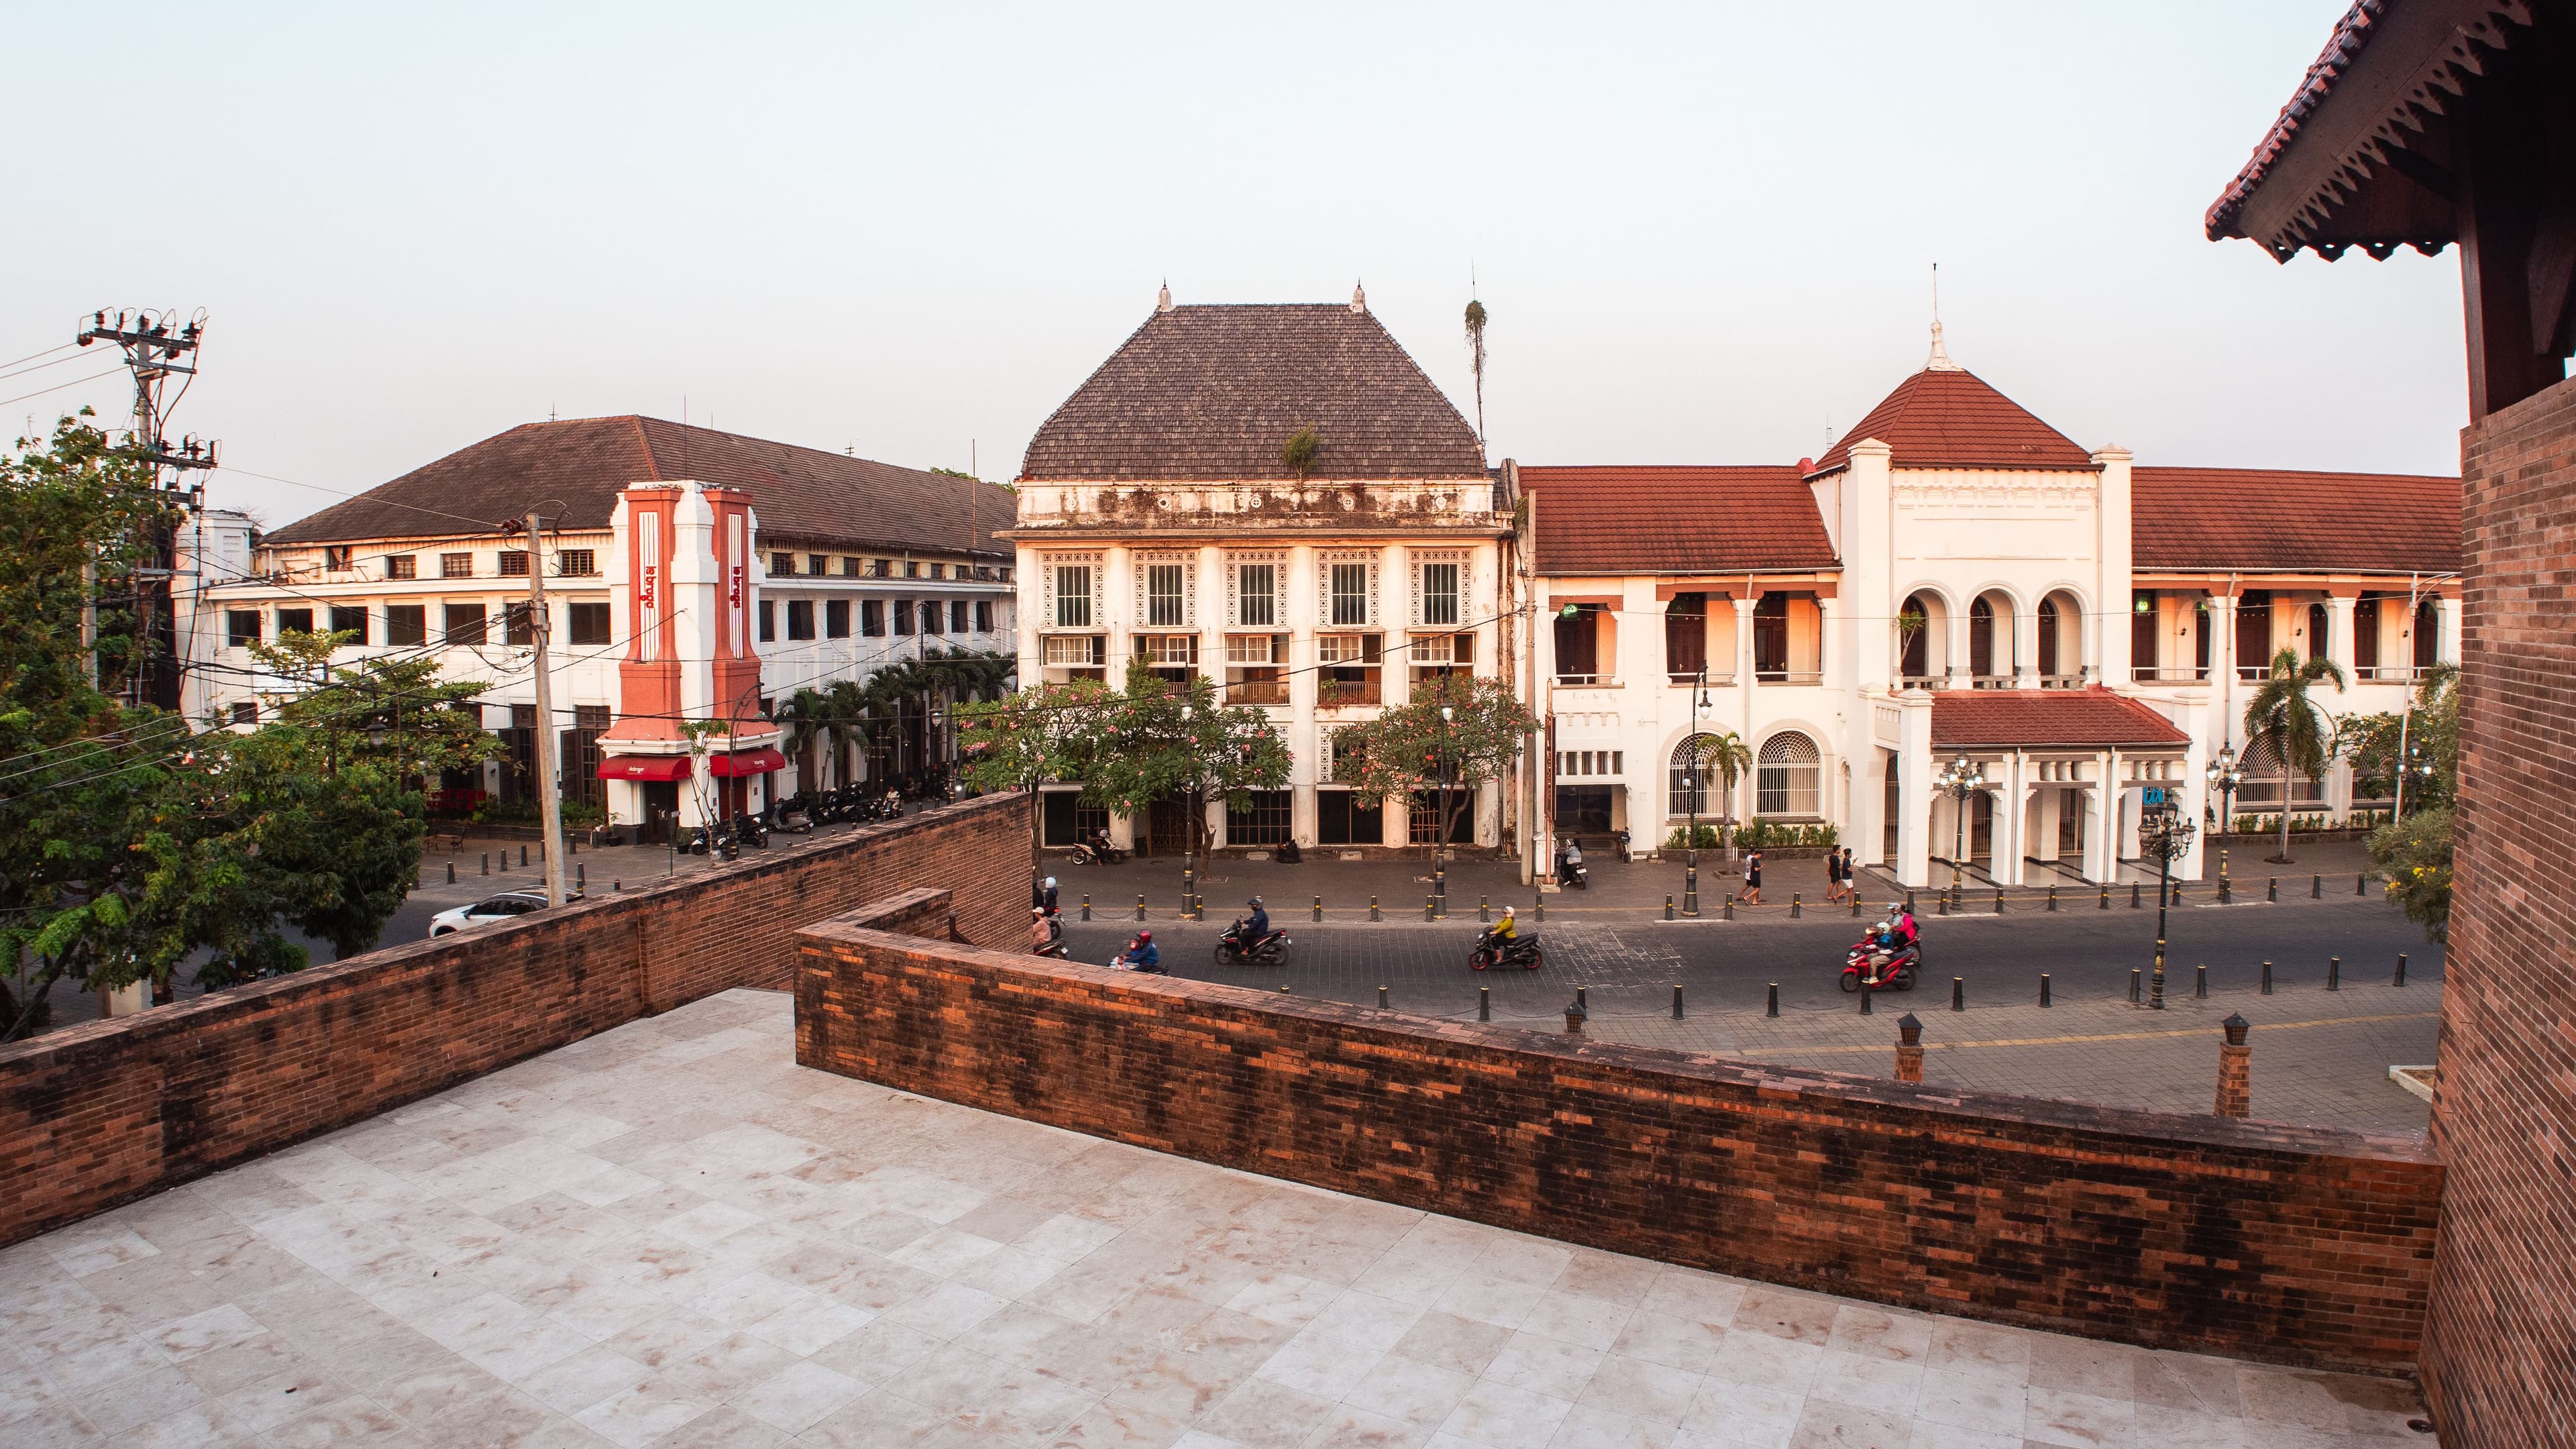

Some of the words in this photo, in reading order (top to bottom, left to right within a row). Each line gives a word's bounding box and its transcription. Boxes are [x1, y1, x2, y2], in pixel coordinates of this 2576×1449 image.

[646, 566, 656, 575] le
[639, 576, 656, 608] braga
[730, 576, 742, 608] braga
